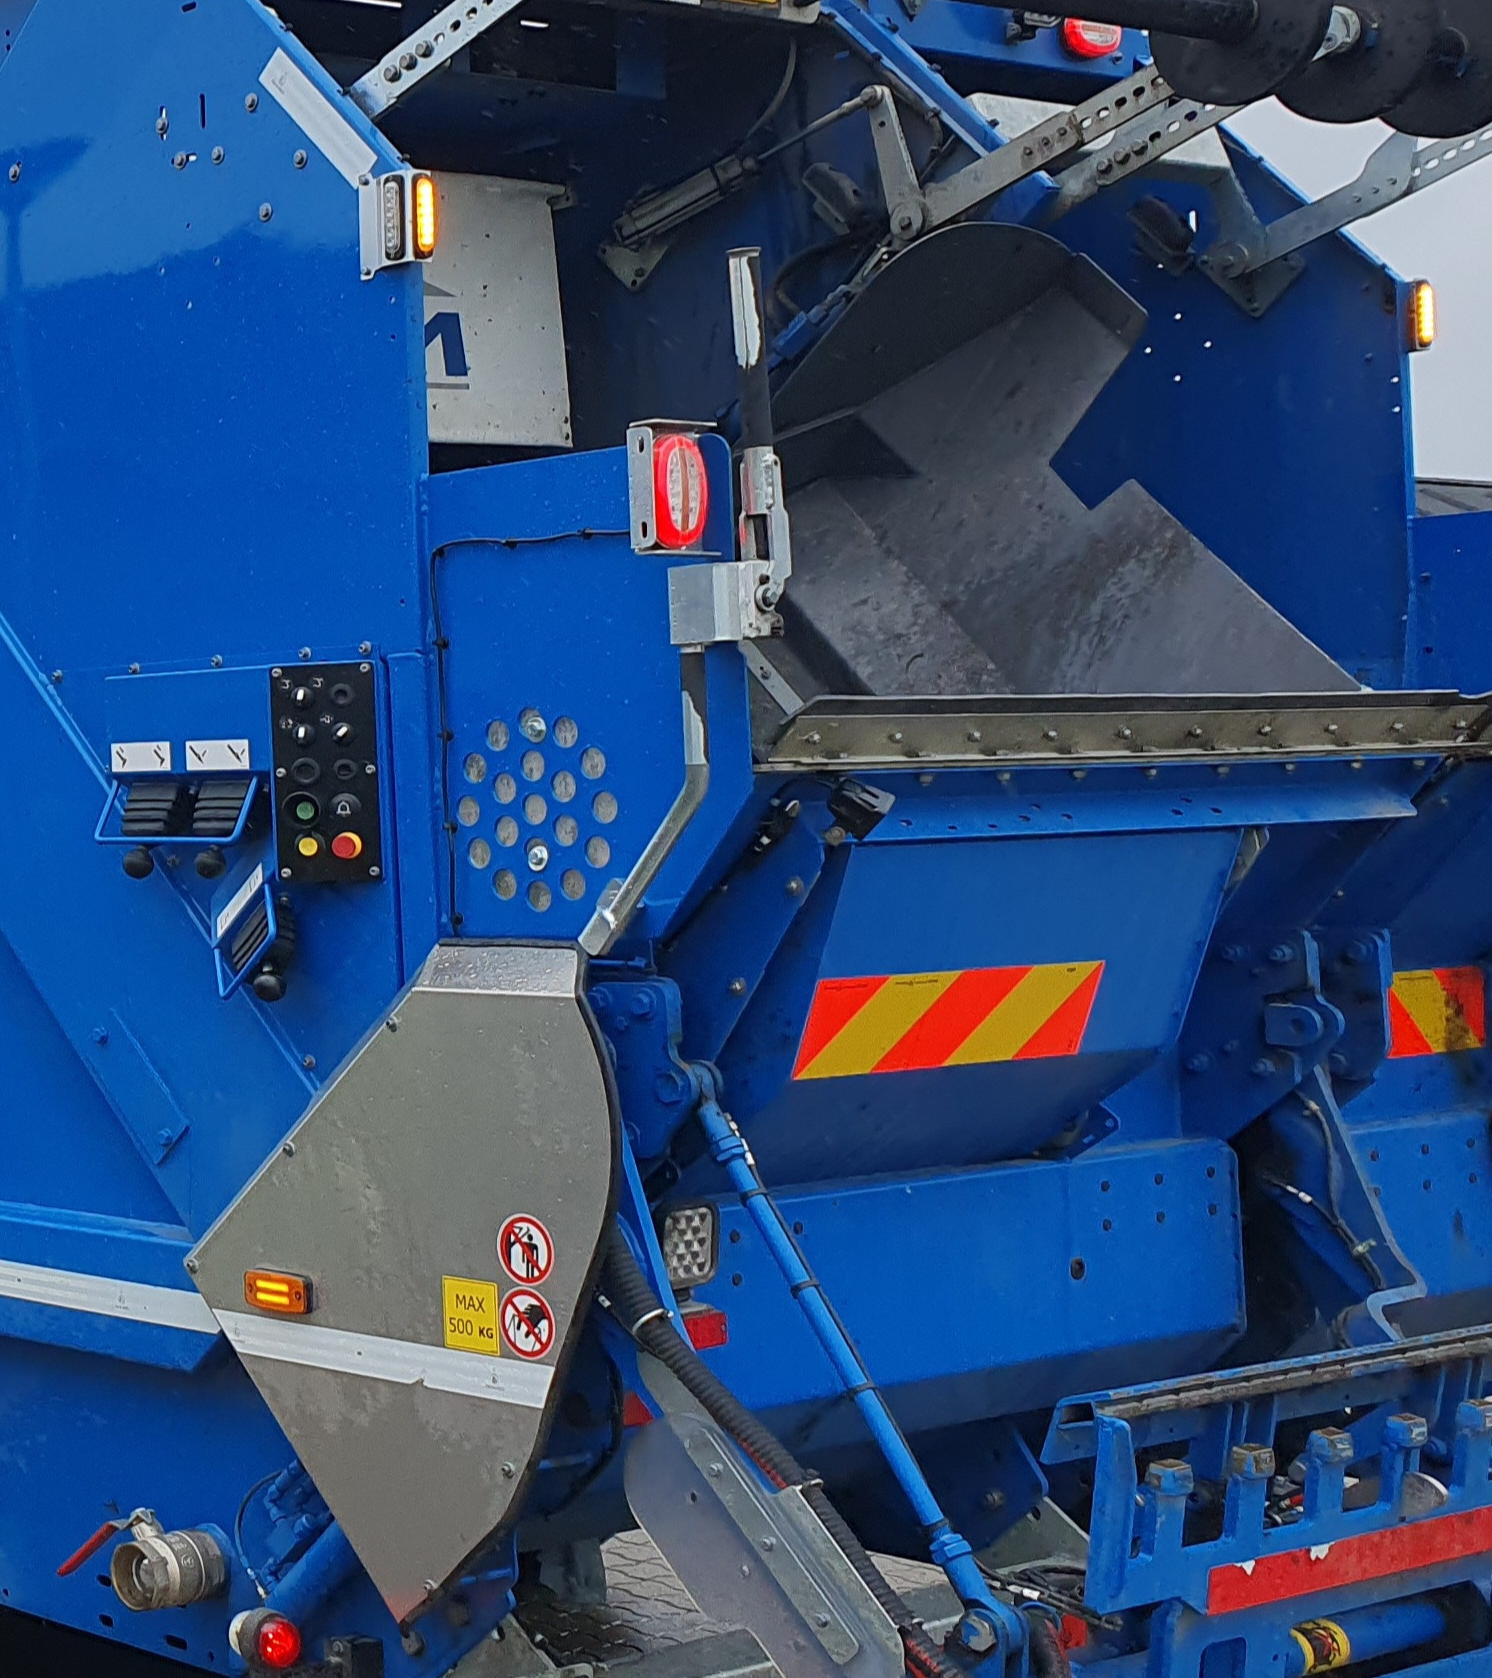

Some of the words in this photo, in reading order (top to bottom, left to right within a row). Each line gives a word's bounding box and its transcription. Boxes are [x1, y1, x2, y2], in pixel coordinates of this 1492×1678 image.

[455, 1293, 486, 1314] MAX
[449, 1316, 474, 1336] 500
[478, 1325, 494, 1339] KG
